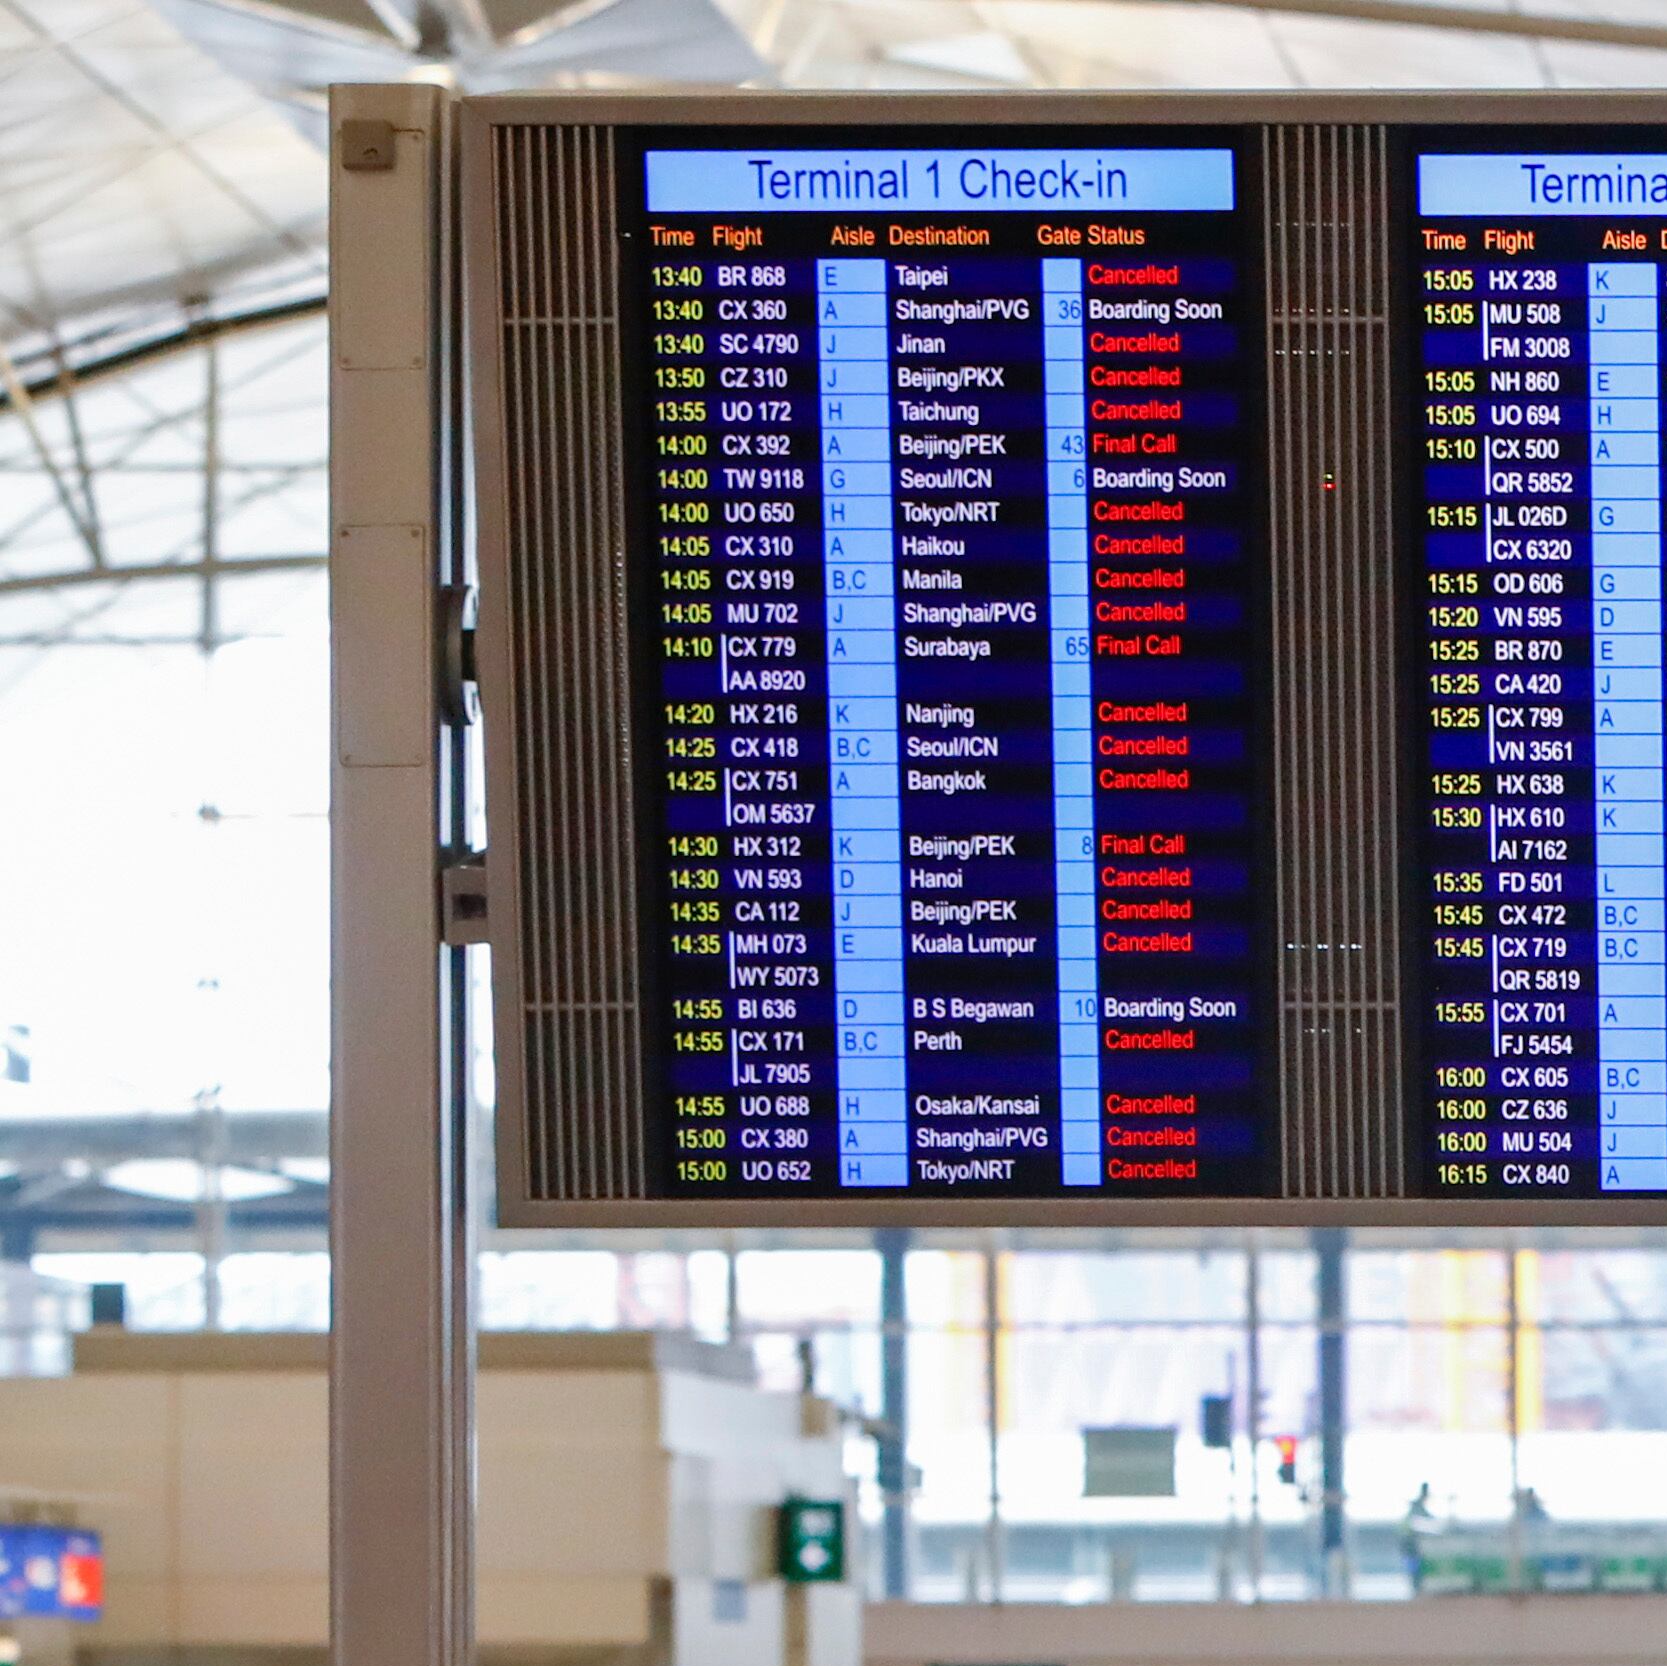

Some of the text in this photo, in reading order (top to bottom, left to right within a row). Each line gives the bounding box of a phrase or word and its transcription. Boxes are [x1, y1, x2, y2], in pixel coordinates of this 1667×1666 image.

[748, 159, 1126, 199] Terminal 1 Check-in
[650, 225, 1145, 250] Time Flight Aisle Destination Gate Status
[1422, 229, 1466, 250] Time
[1485, 229, 1534, 255] Flight
[1603, 230, 1647, 249] Aisle
[654, 299, 1222, 324] 13:40 CX 360 A Shanghai/PVG 36 Boarding Soon
[1428, 506, 1477, 526] 15:15
[1493, 507, 1514, 526] JL
[1518, 506, 1567, 526] 026D
[1599, 506, 1614, 526] G
[678, 1159, 1196, 1184] 15:00 UO 652 H Tokyo/NRT Cancelled
[1439, 1165, 1487, 1183] 16:15
[1503, 1164, 1531, 1184] CX
[1536, 1165, 1569, 1184] 840
[1606, 1166, 1619, 1183] A
